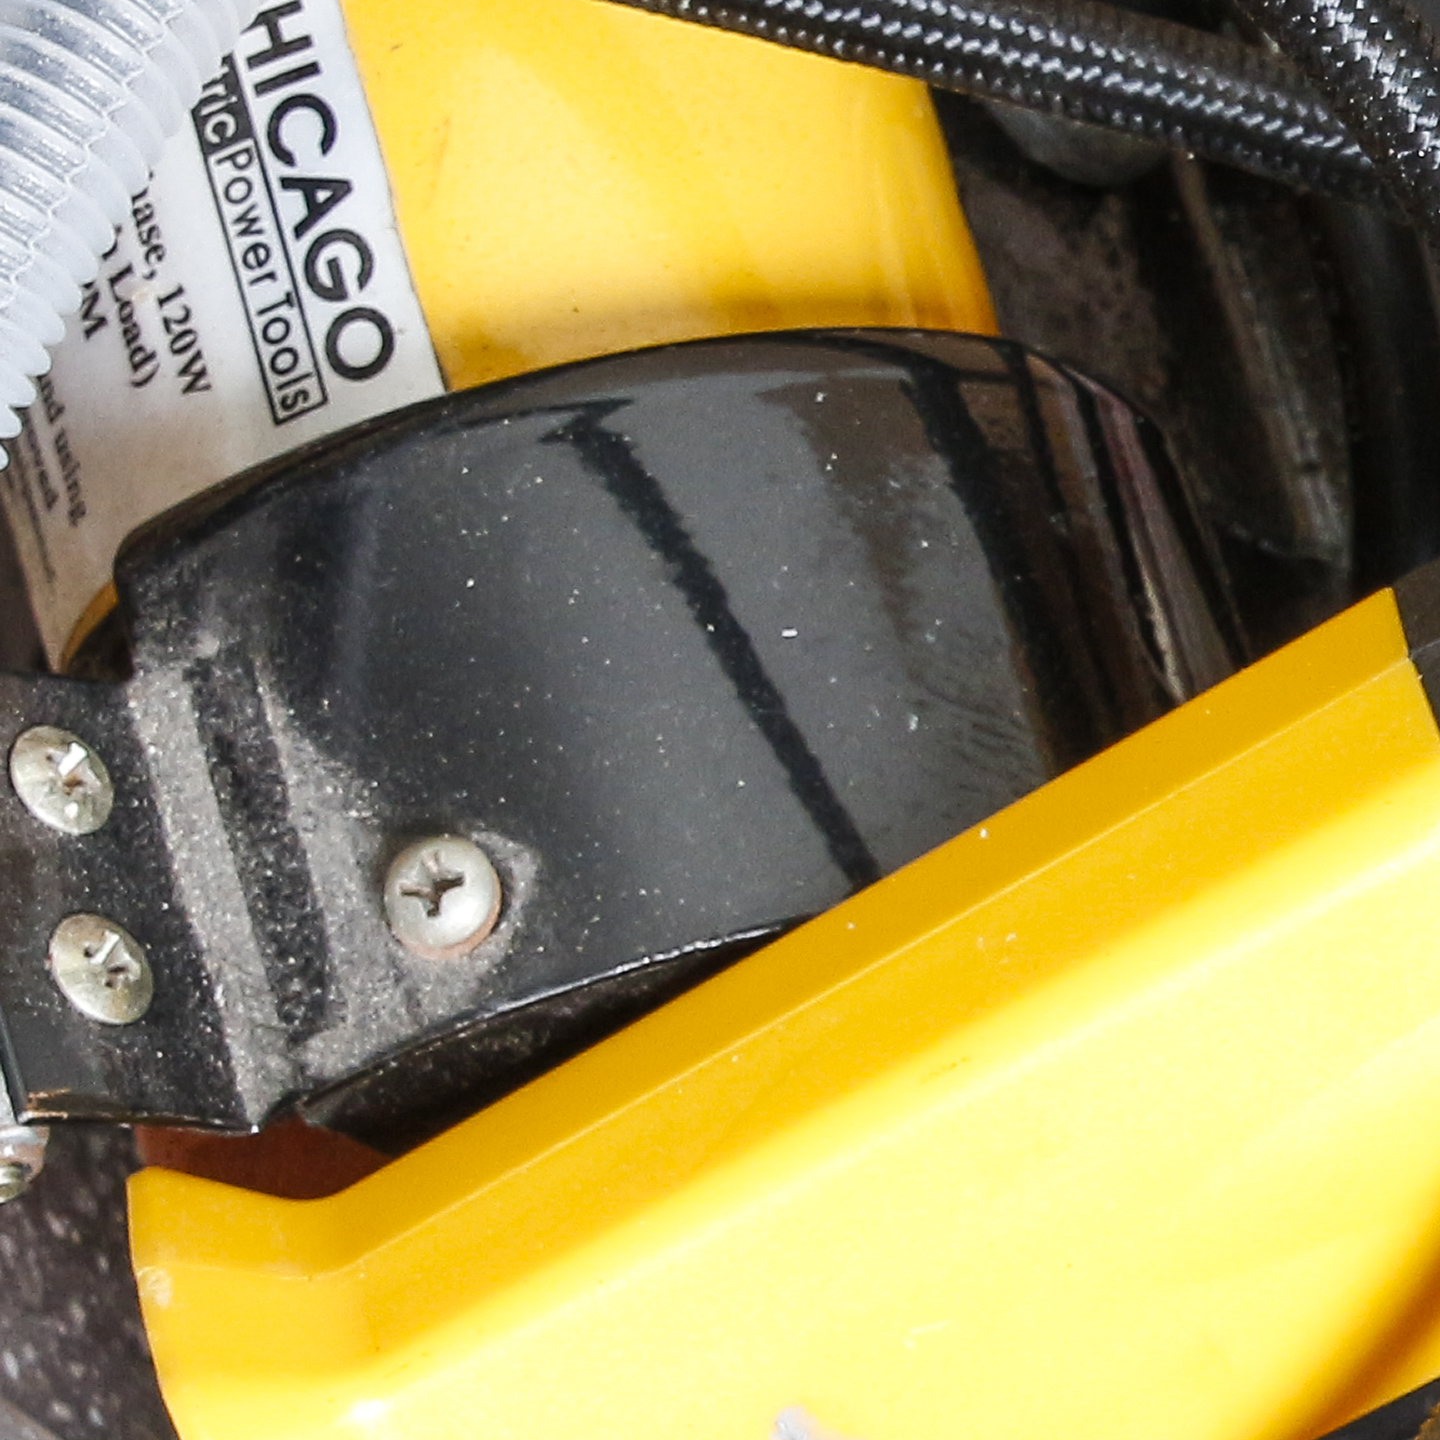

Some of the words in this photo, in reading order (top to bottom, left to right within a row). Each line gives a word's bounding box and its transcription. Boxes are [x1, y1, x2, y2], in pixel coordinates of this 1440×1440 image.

[104, 266, 158, 389] Load)
[153, 278, 215, 397] 120W
[219, 147, 276, 292] Power
[257, 287, 312, 414] Tools
